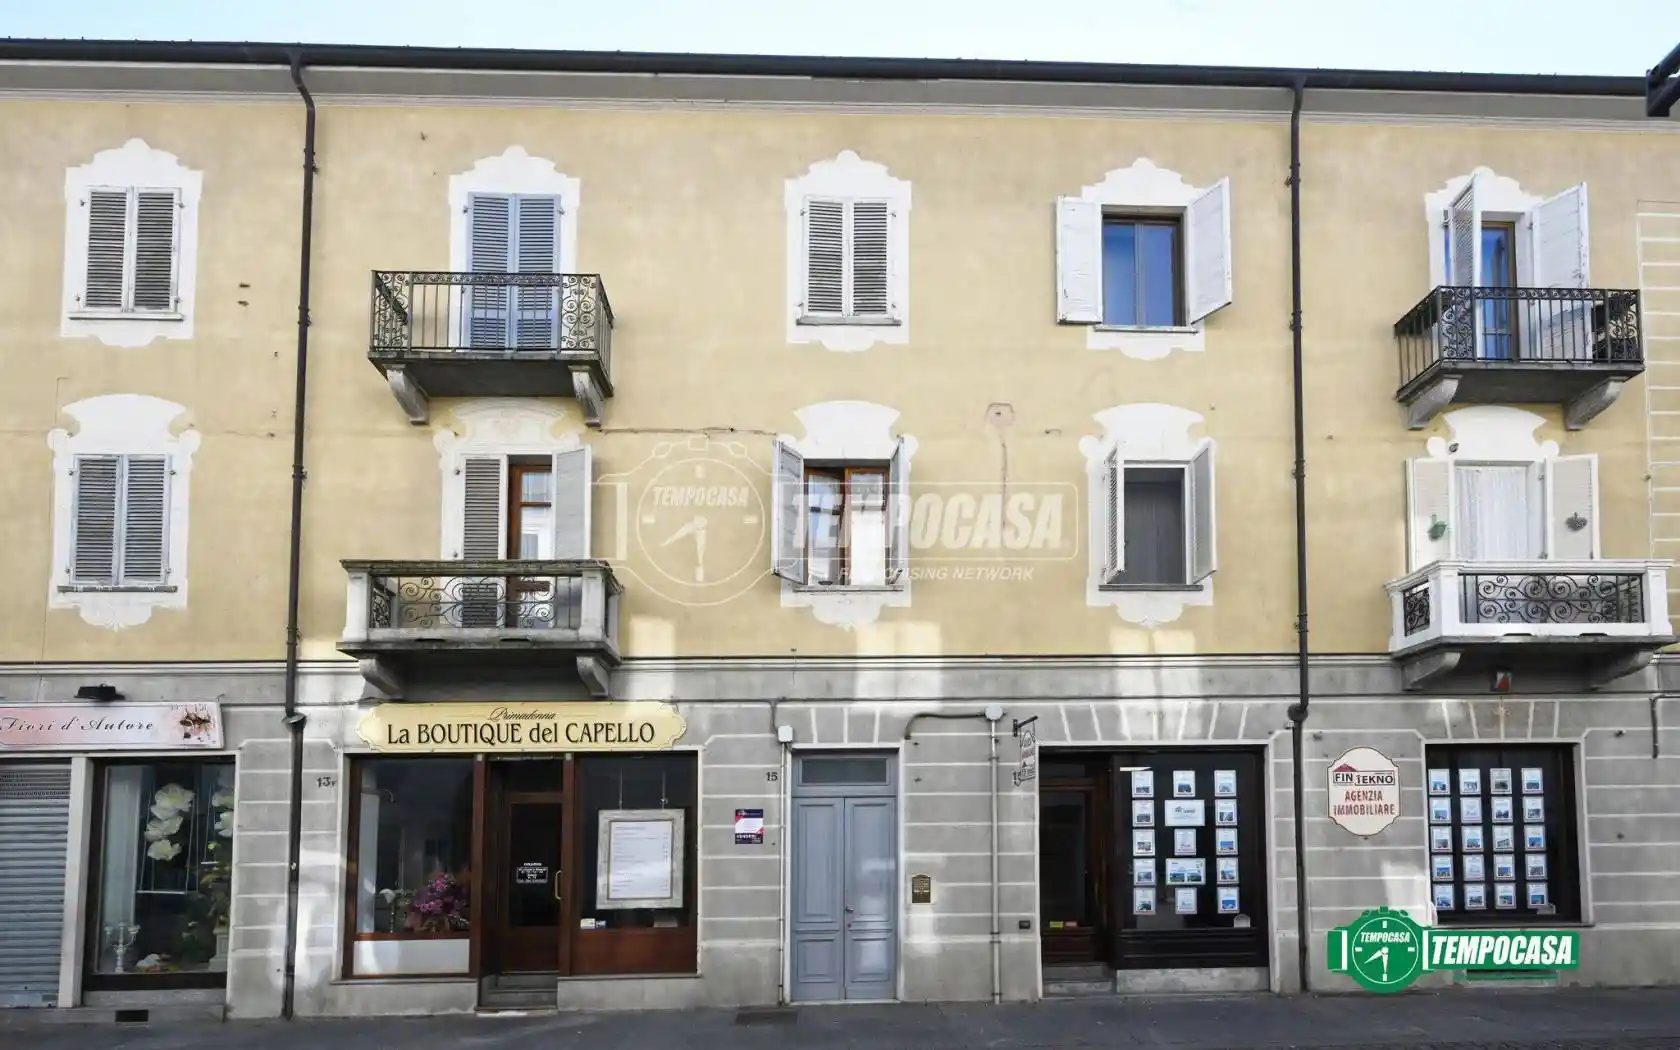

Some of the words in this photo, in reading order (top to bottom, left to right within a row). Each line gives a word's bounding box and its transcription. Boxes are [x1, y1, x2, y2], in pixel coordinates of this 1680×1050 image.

[488, 706, 557, 722] Primadonna
[0, 716, 53, 732] Fiori
[387, 724, 410, 744] La
[417, 723, 522, 746] BOUTIQUE
[529, 722, 558, 743] del
[565, 722, 655, 743] CAPELLO
[766, 771, 779, 781] 15
[1335, 773, 1353, 782] FIN
[1356, 775, 1394, 784] TEKNO
[1344, 790, 1383, 802] AGENZIA
[1333, 803, 1395, 816] IMMOBILIARE
